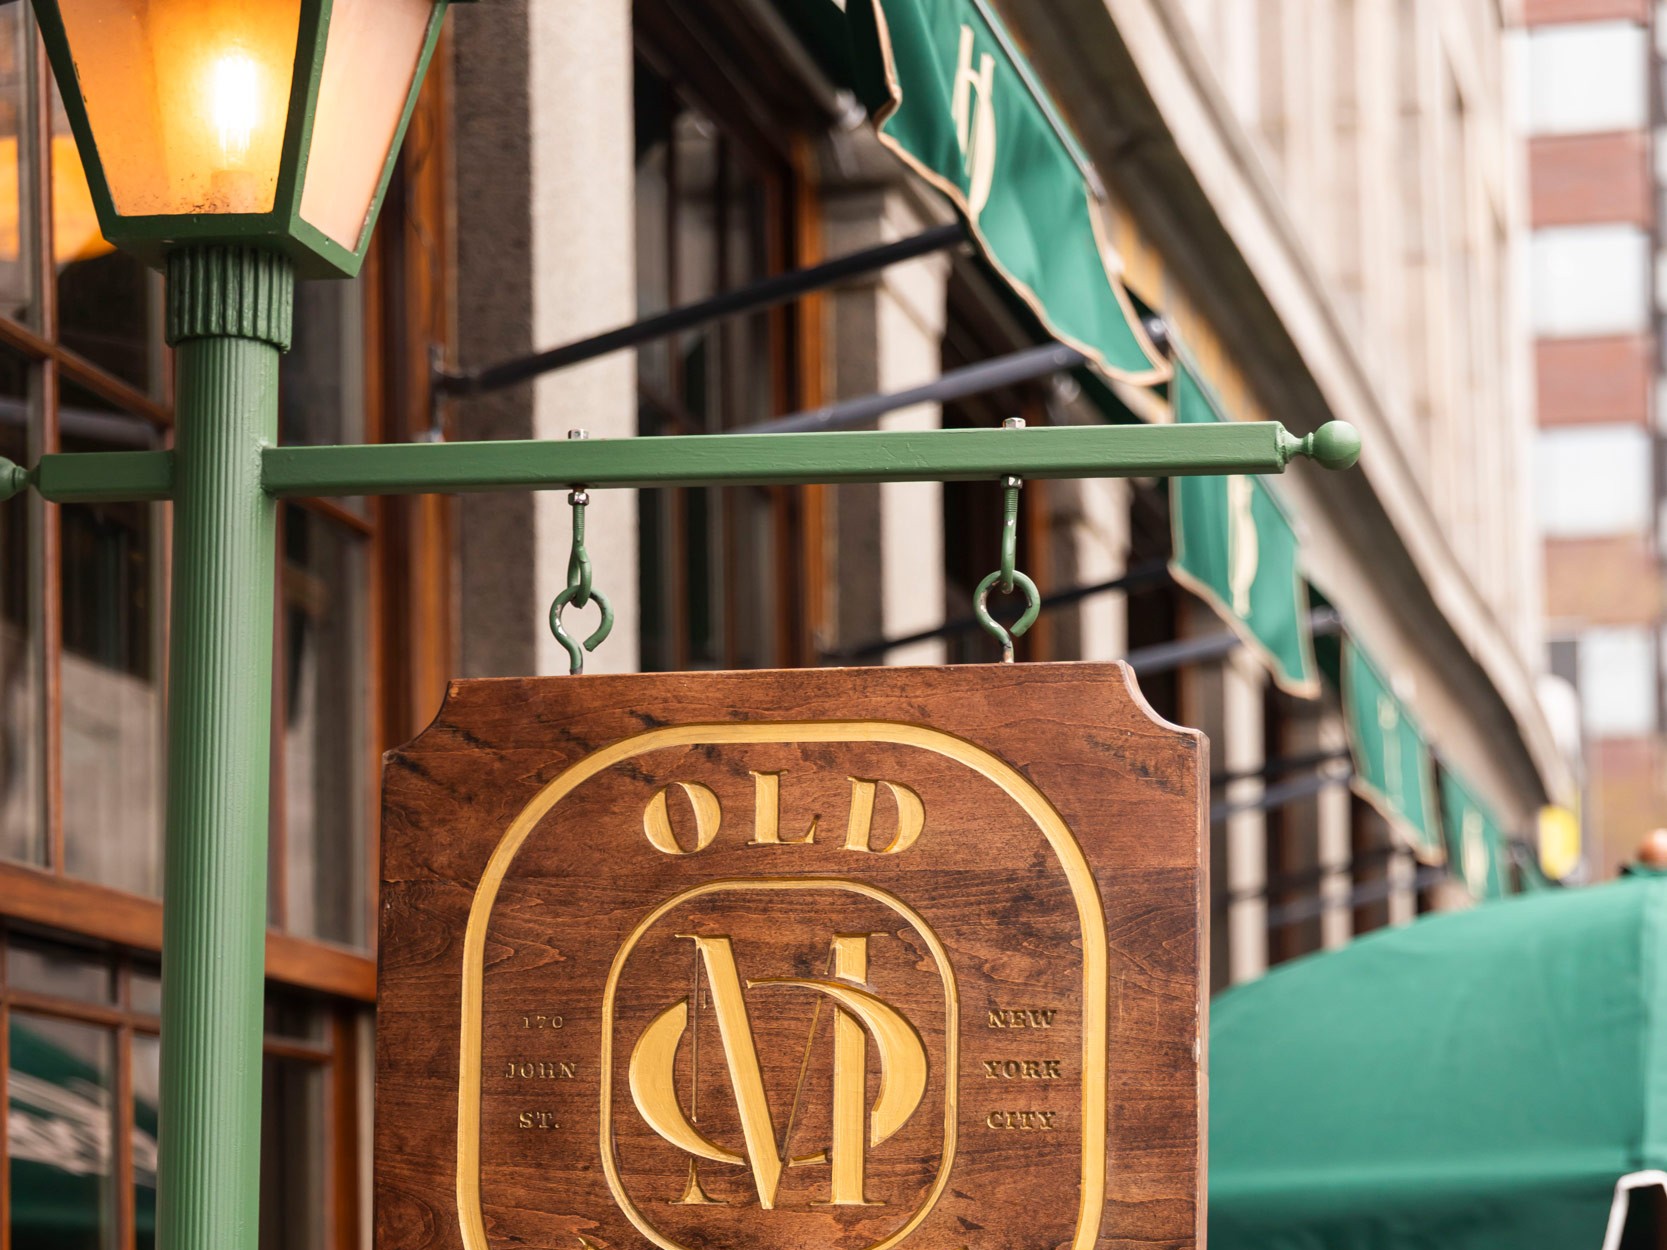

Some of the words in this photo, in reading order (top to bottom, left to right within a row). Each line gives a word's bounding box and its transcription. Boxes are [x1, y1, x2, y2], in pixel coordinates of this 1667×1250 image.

[642, 768, 926, 855] OLD
[522, 1015, 563, 1029] 170
[987, 1009, 1057, 1029] NEW
[505, 1062, 578, 1079] JOHN
[982, 1060, 1061, 1079] YORK
[519, 1111, 561, 1129] ST.
[986, 1111, 1056, 1130] CITY
